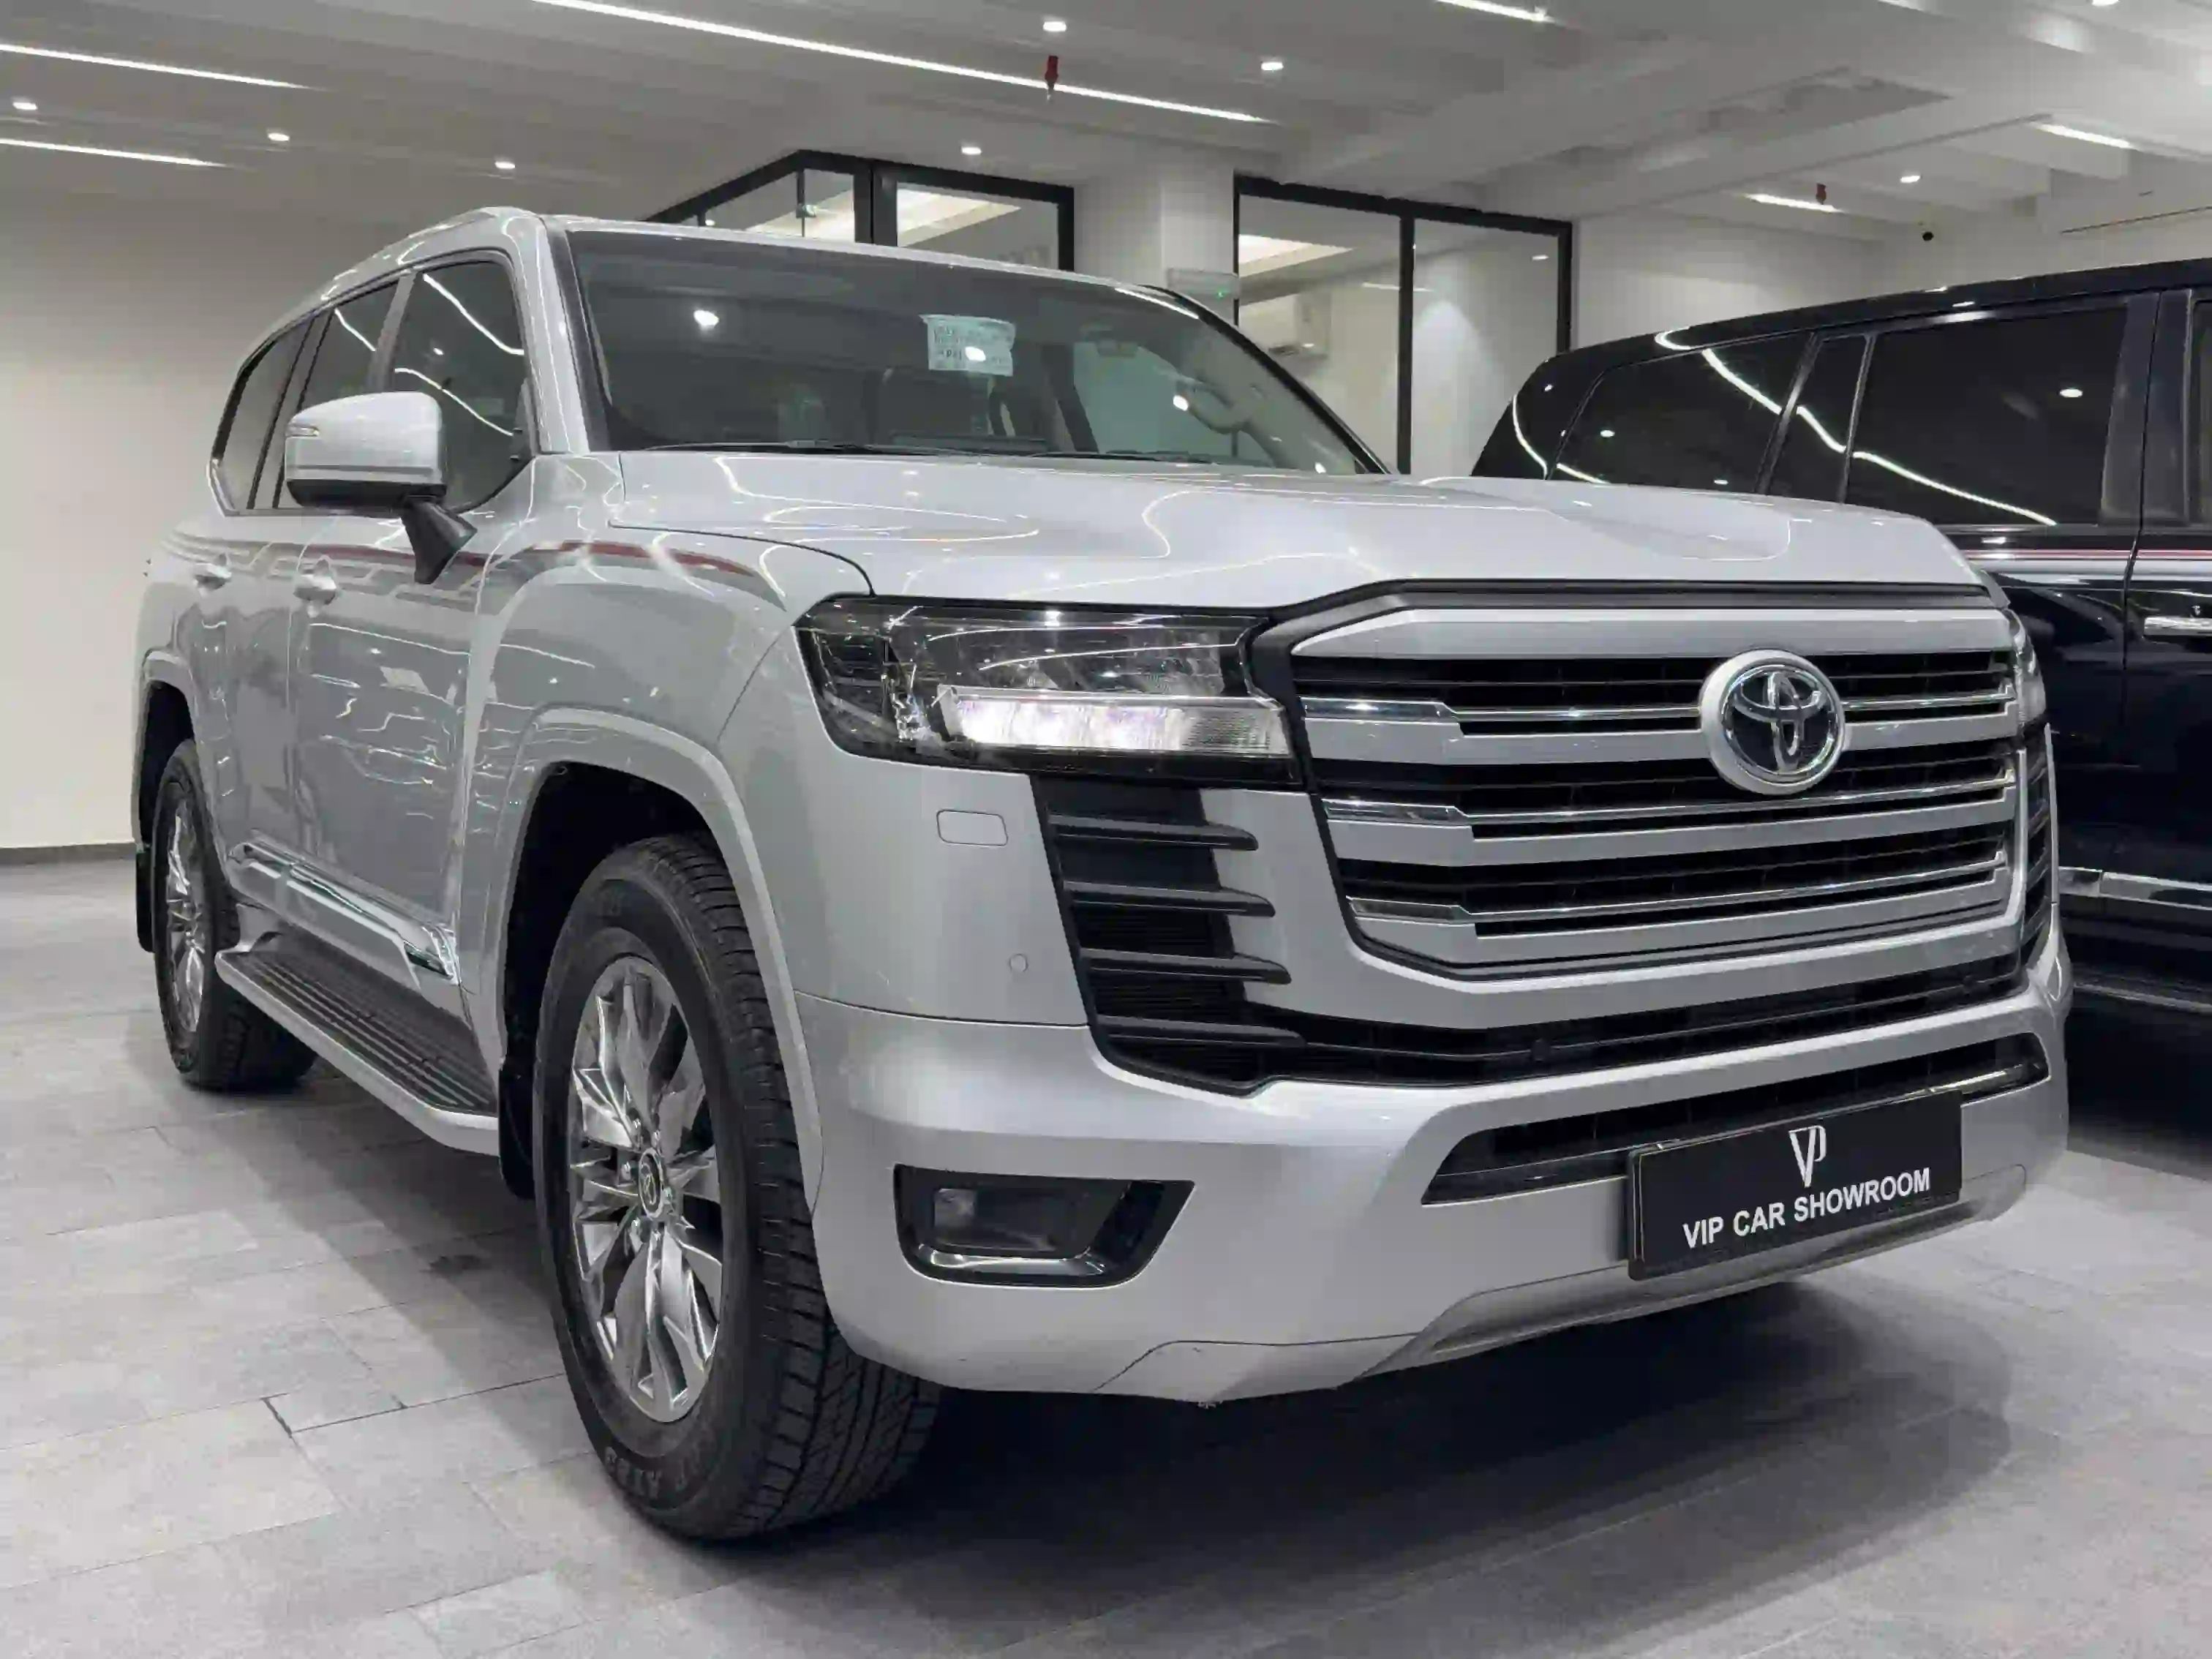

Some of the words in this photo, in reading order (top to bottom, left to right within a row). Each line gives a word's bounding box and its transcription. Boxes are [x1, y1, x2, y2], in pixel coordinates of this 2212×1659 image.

[1682, 1216, 1724, 1249] VIP
[1733, 1202, 1786, 1237] CAR
[1794, 1167, 1930, 1222] SHOWROOM
